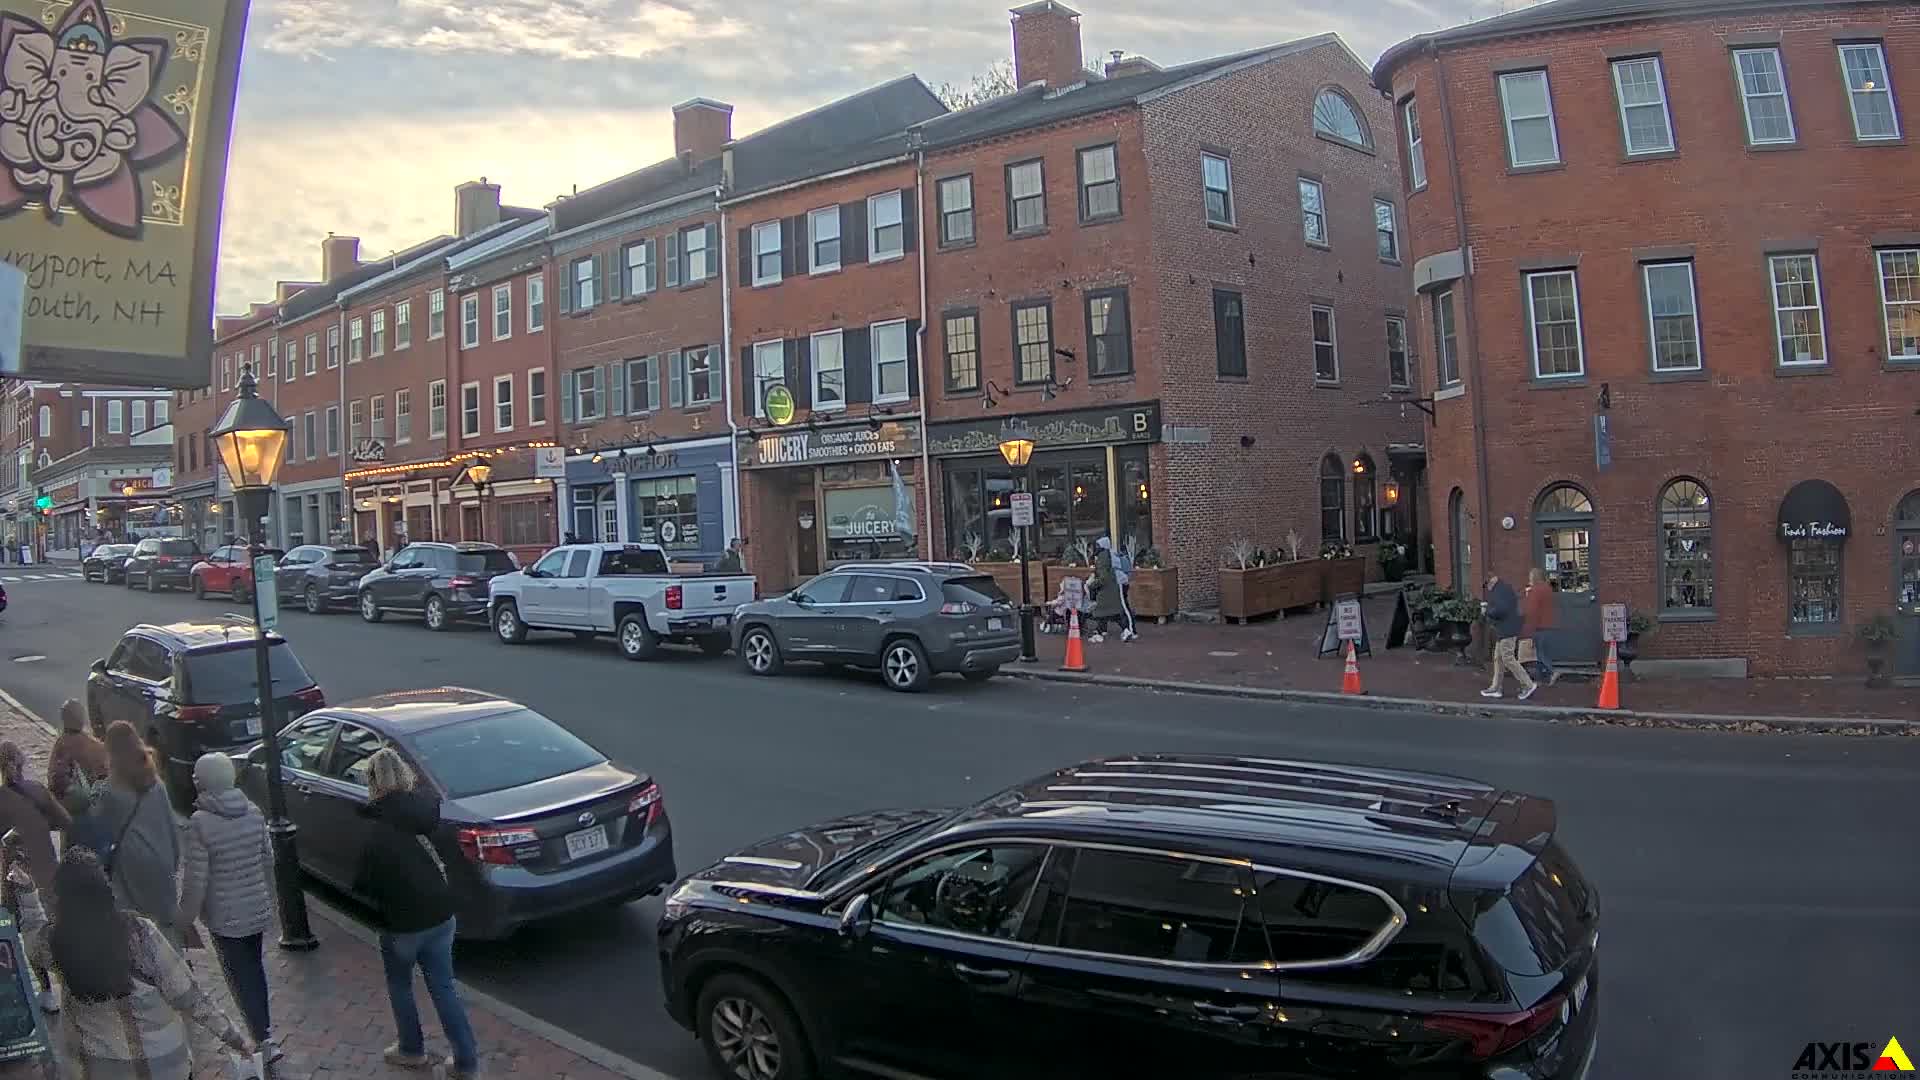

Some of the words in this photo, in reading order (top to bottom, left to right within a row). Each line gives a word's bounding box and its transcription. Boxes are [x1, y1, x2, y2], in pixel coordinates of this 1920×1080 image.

[124, 257, 177, 288] MA
[113, 300, 166, 326] NH
[1133, 413, 1147, 432] B
[758, 434, 809, 464] JUICERY
[821, 431, 853, 445] ORGANIC
[854, 430, 880, 442] JUICES
[808, 445, 849, 459] SMOOTHIES
[854, 443, 876, 455] GOOD
[877, 440, 896, 452] EATS
[846, 520, 897, 535] JUICERY
[1782, 522, 1806, 537] Tina's
